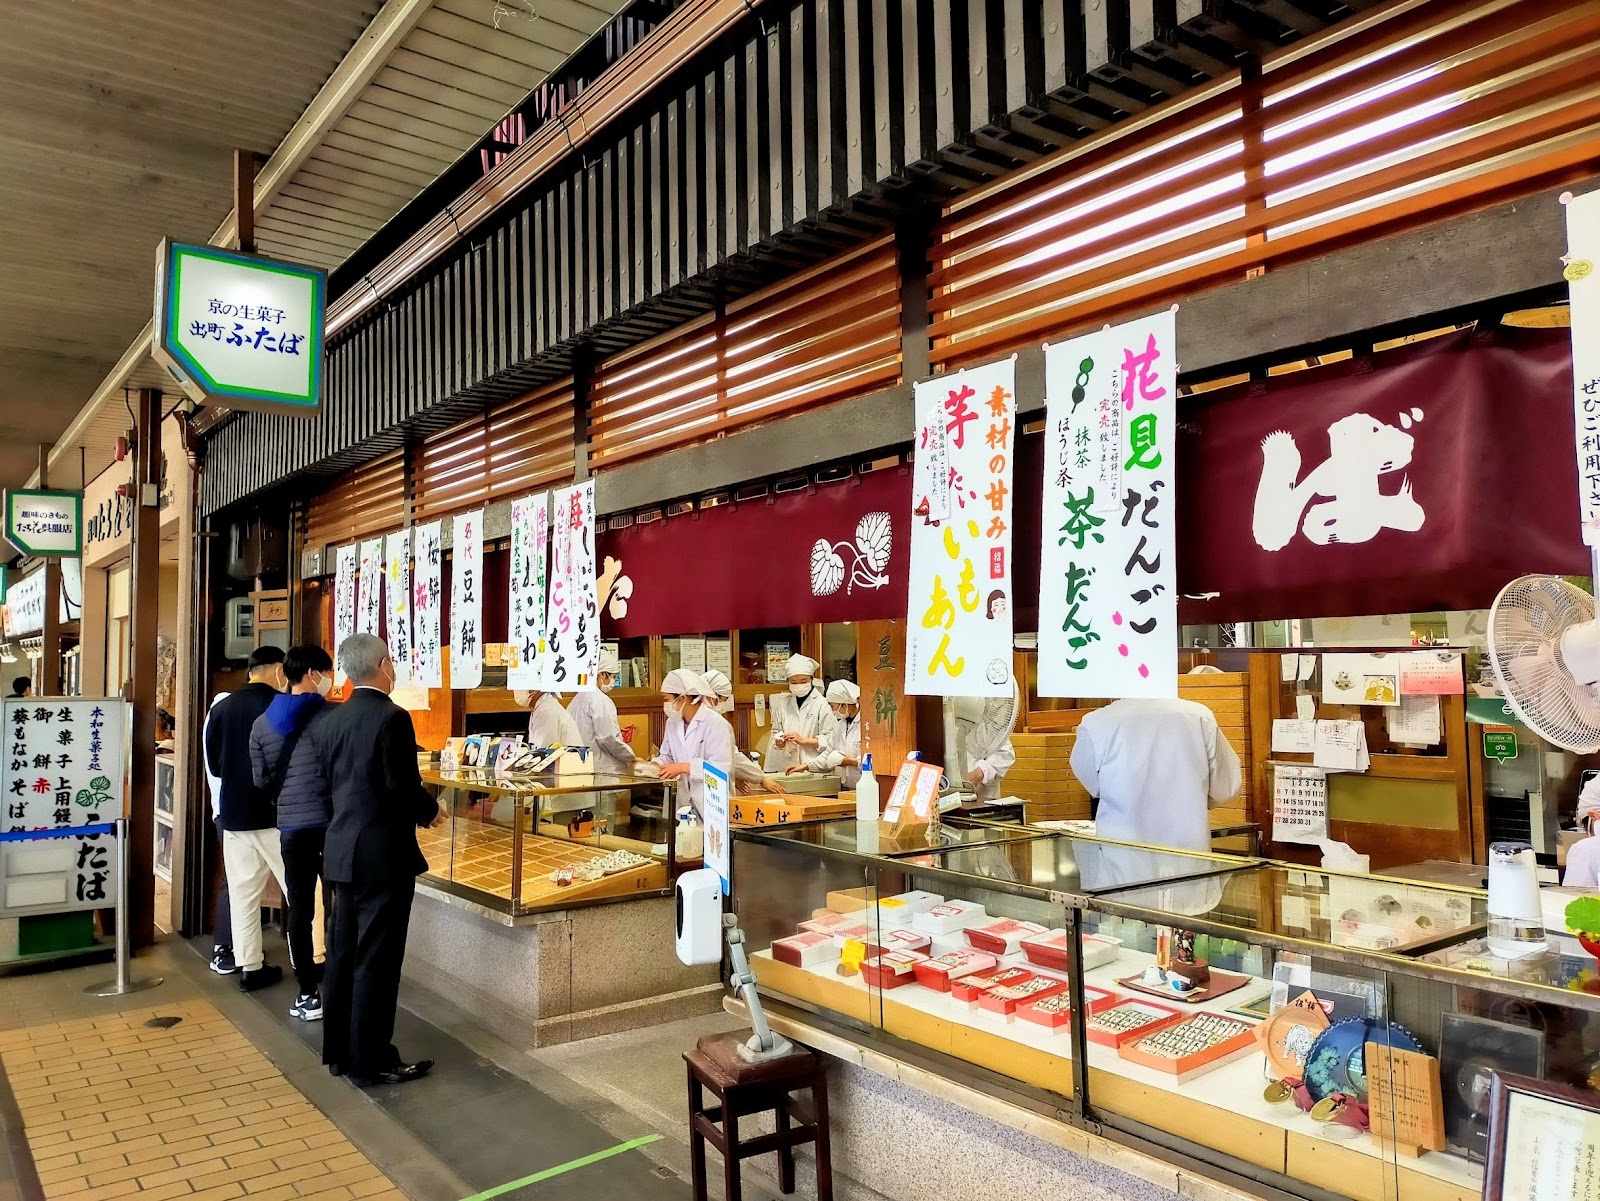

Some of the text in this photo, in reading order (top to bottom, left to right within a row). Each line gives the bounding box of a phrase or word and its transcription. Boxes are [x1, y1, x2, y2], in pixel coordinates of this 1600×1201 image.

[207, 298, 287, 323] 京の生菓子
[984, 385, 1013, 541] 素材の甘み
[1054, 417, 1074, 489] ほうじ茶
[1074, 425, 1092, 469] 抹茶
[1121, 332, 1166, 634] 花見だんご
[1059, 486, 1106, 671] 茶だんご
[11, 708, 29, 772] 葵もなか
[55, 707, 74, 769] 生菓子
[732, 804, 791, 824] ふたば
